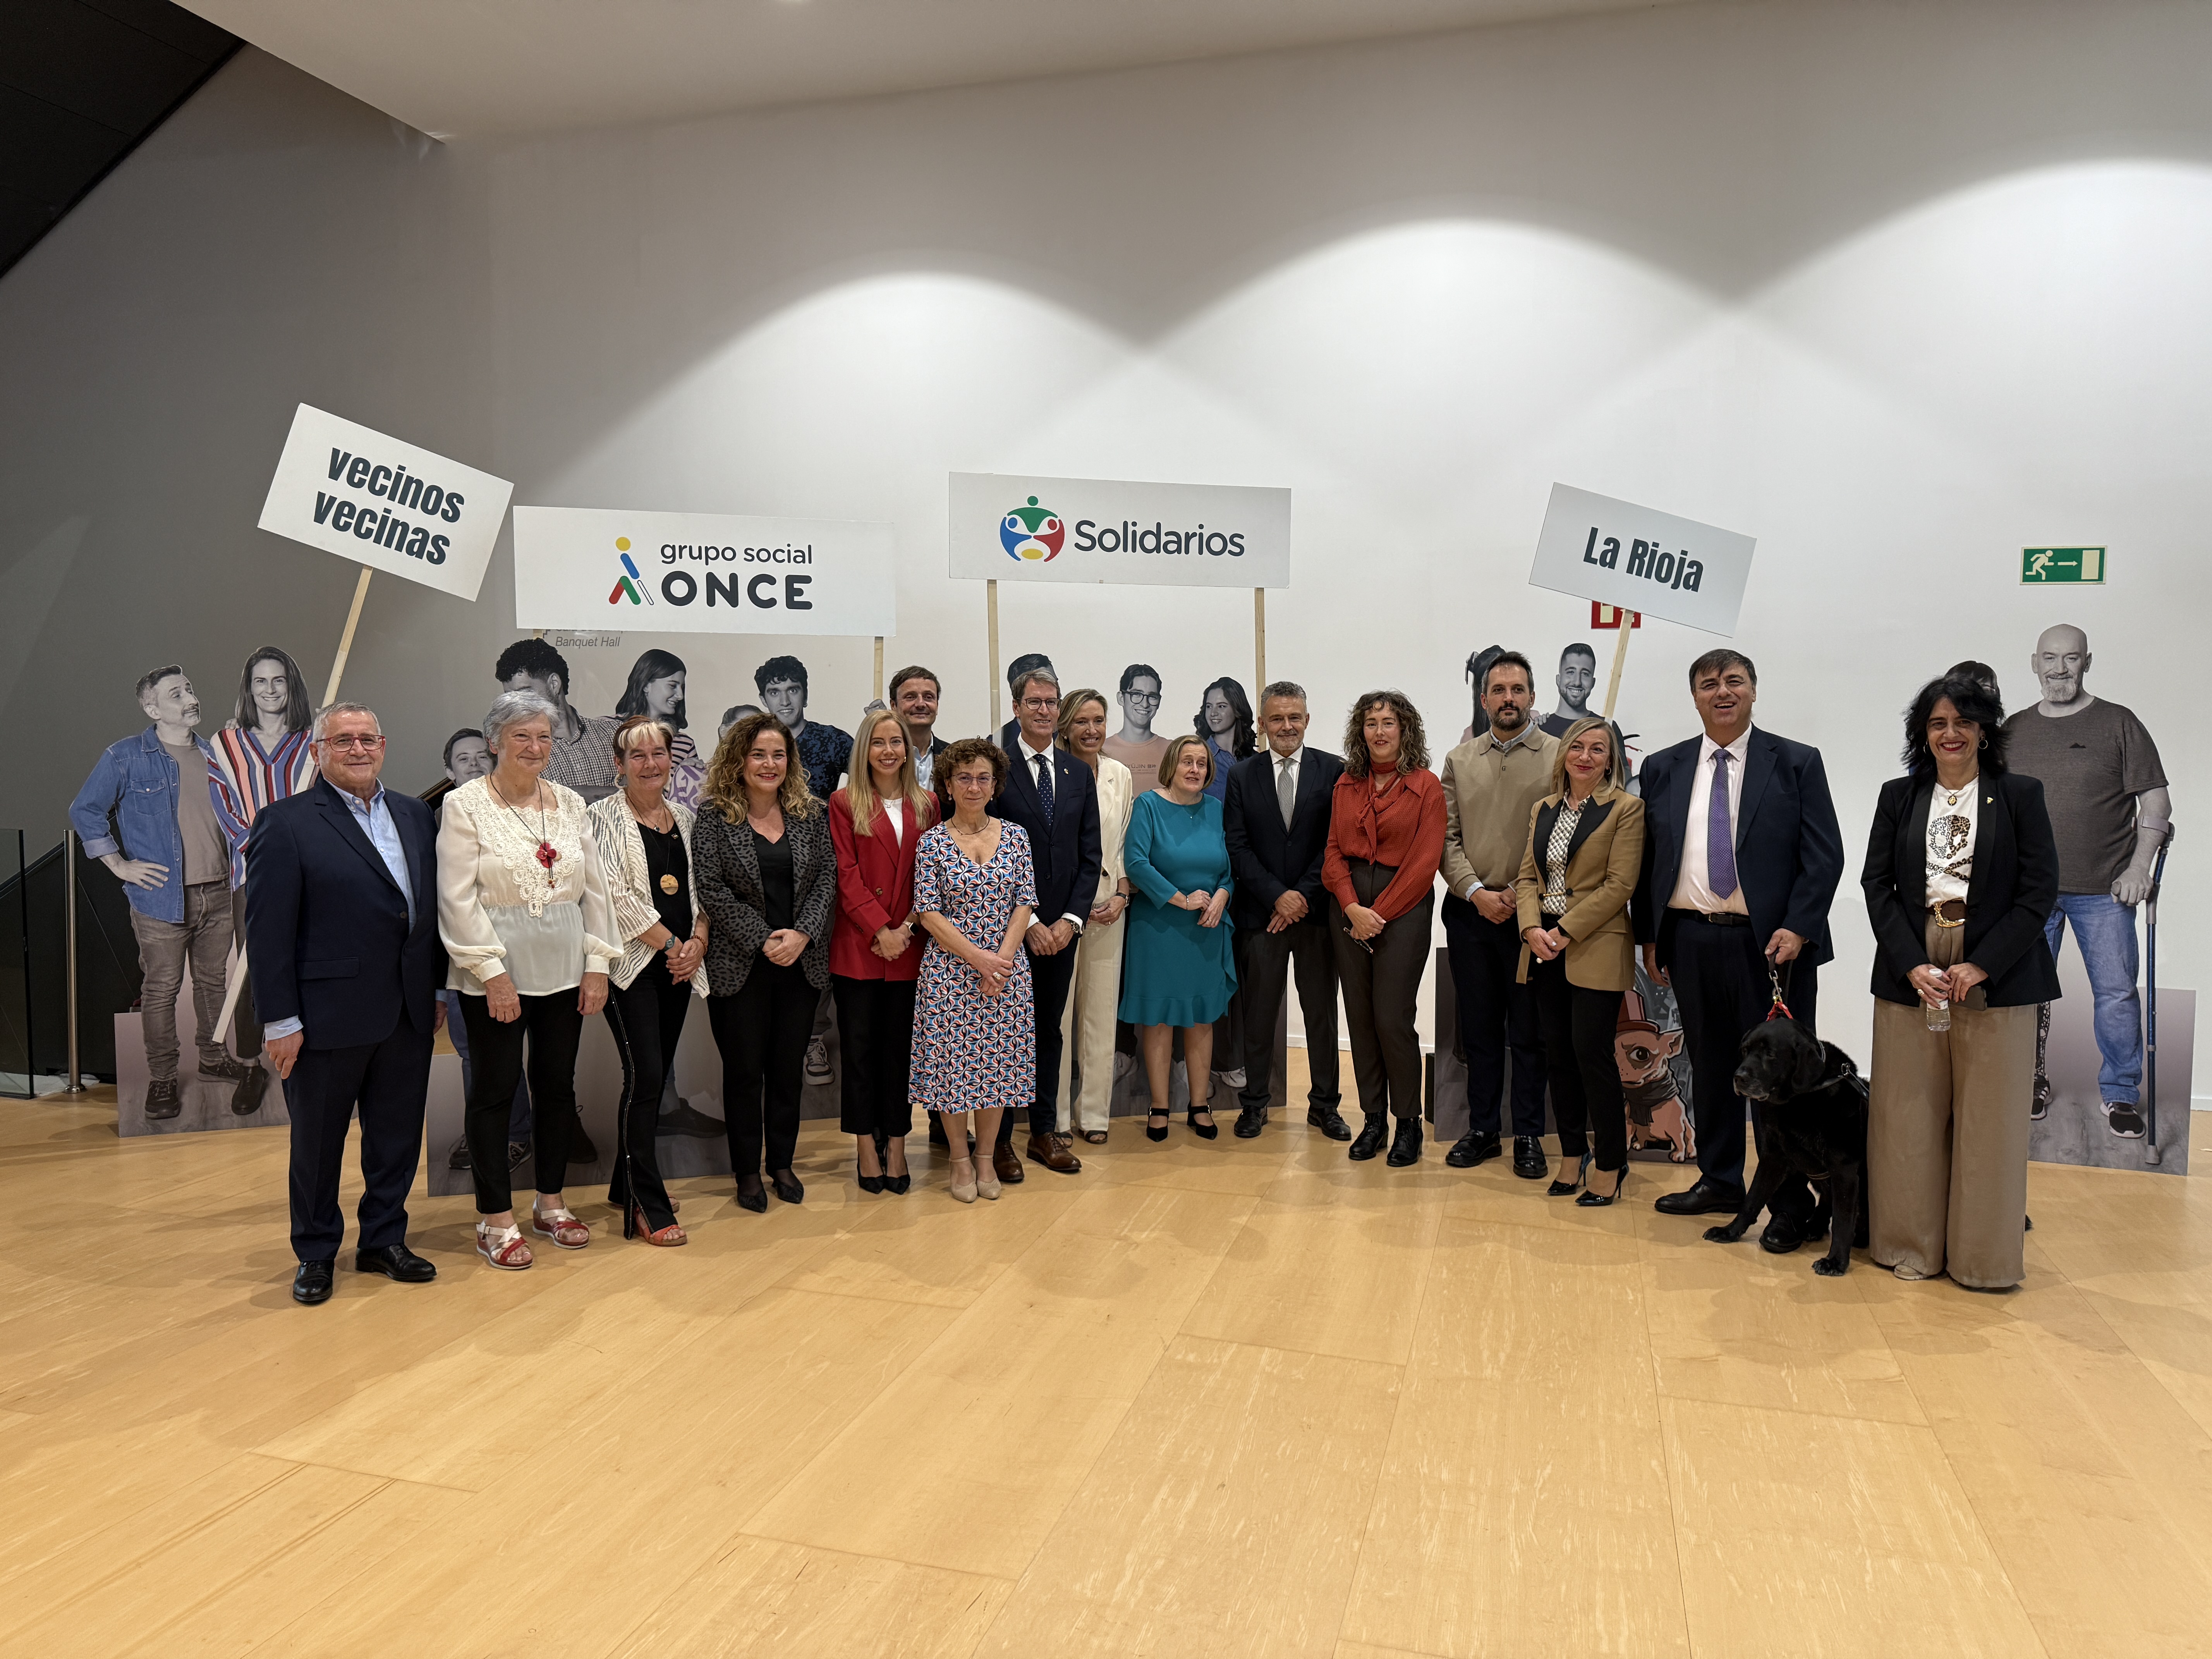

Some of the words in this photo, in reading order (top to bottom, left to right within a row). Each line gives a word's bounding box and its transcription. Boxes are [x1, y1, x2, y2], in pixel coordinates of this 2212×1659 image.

[328, 448, 465, 523] vecinos
[314, 491, 450, 565] vecinas
[1074, 520, 1245, 556] Solidarios
[661, 544, 737, 566] grupo
[743, 544, 812, 565] social
[1583, 527, 1620, 570] La
[1626, 539, 1704, 593] Rioja
[661, 570, 813, 610] ONCE
[555, 636, 598, 649] Banquet
[601, 636, 621, 647] Hall
